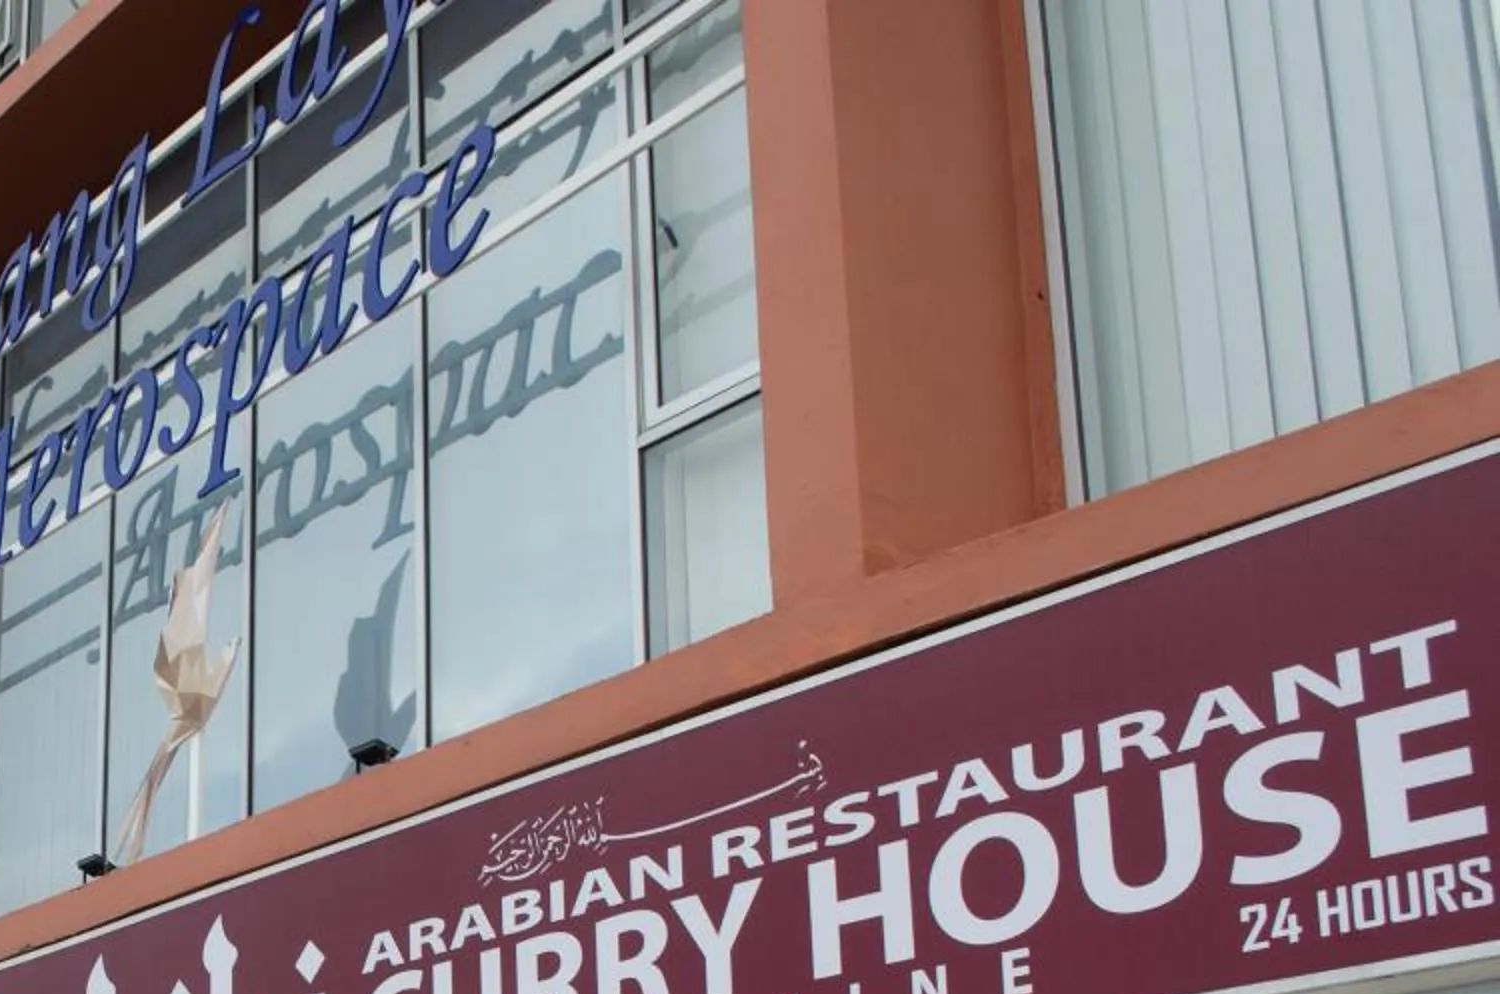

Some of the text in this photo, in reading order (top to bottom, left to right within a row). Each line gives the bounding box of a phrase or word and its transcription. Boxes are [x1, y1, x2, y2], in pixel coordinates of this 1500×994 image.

[362, 619, 1458, 974] ARABIAN RESTAURANT
[806, 688, 1489, 981] HOUSE
[1240, 855, 1495, 954] 24 HOURS
